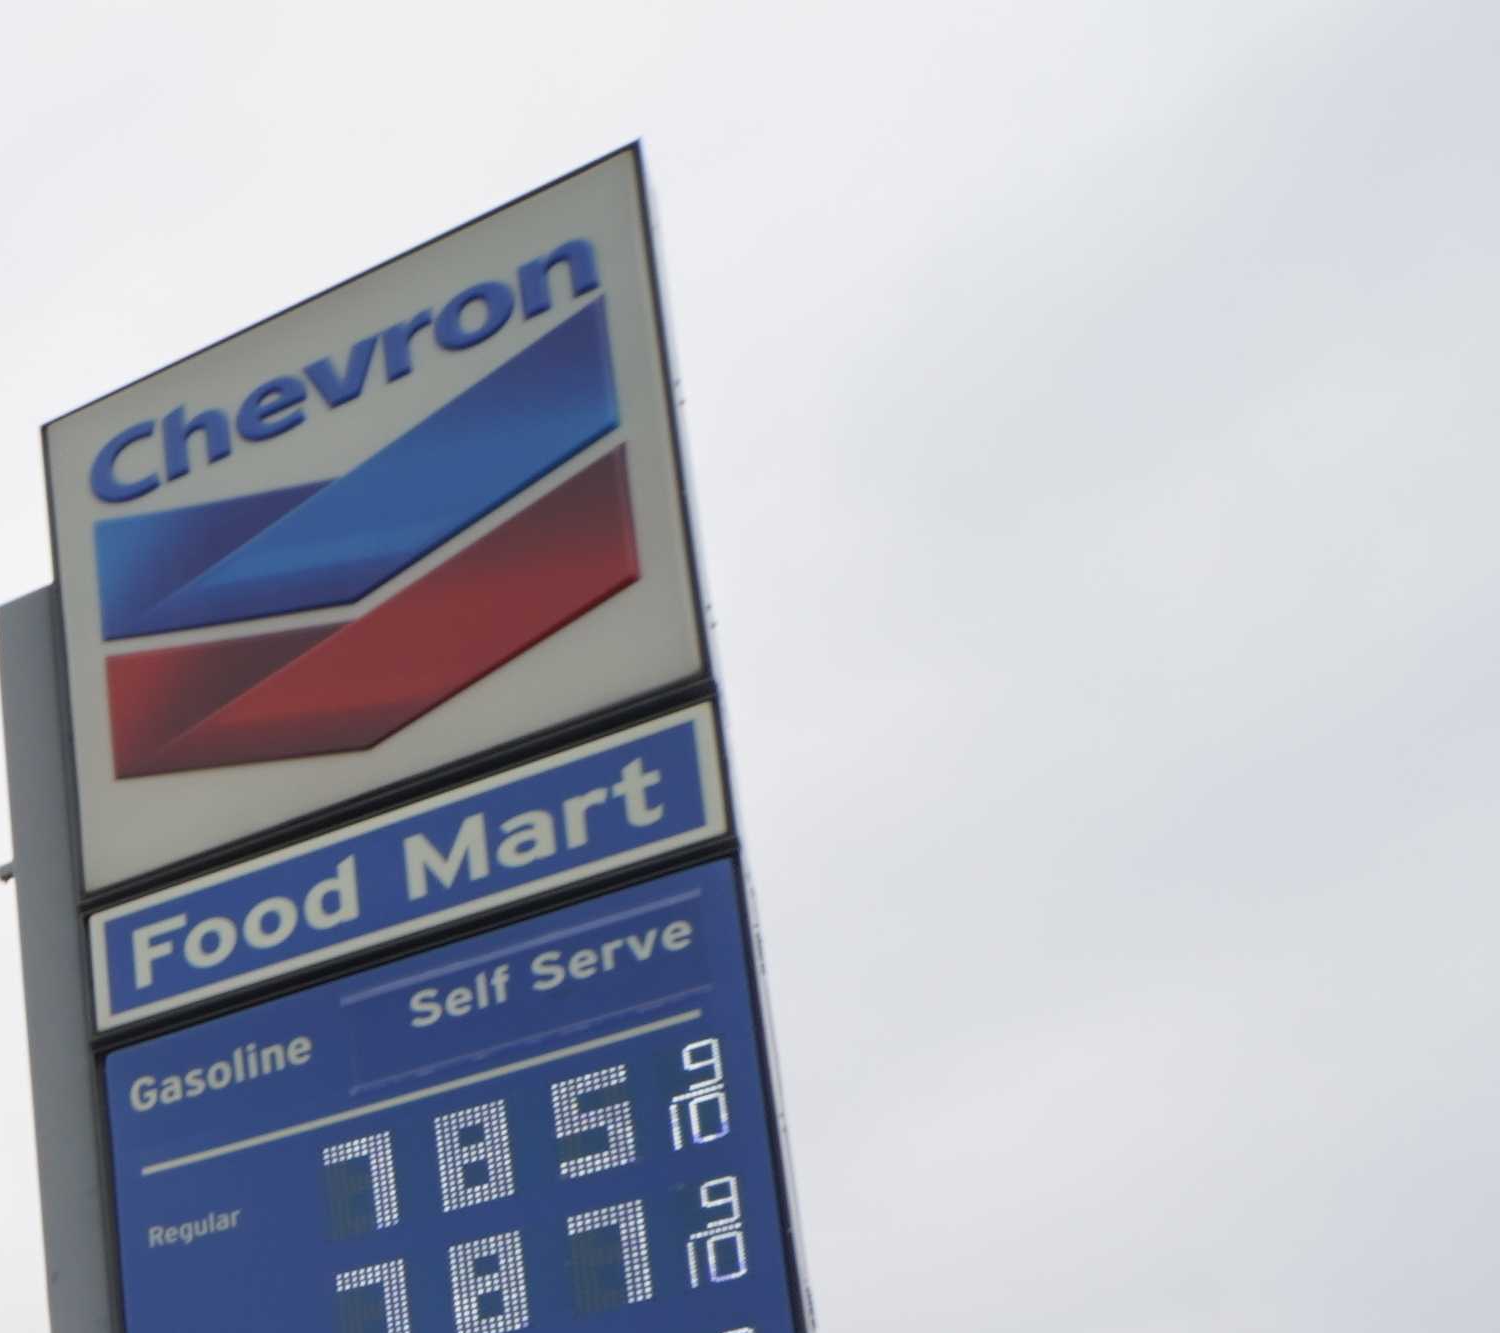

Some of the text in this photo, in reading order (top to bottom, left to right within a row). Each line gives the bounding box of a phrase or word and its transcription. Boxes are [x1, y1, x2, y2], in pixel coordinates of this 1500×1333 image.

[88, 236, 599, 505] Chevron
[131, 756, 665, 990] Food Mart
[408, 917, 695, 1028] Self Serve
[128, 1034, 313, 1114] Gasoline
[147, 1206, 242, 1249] Regular
